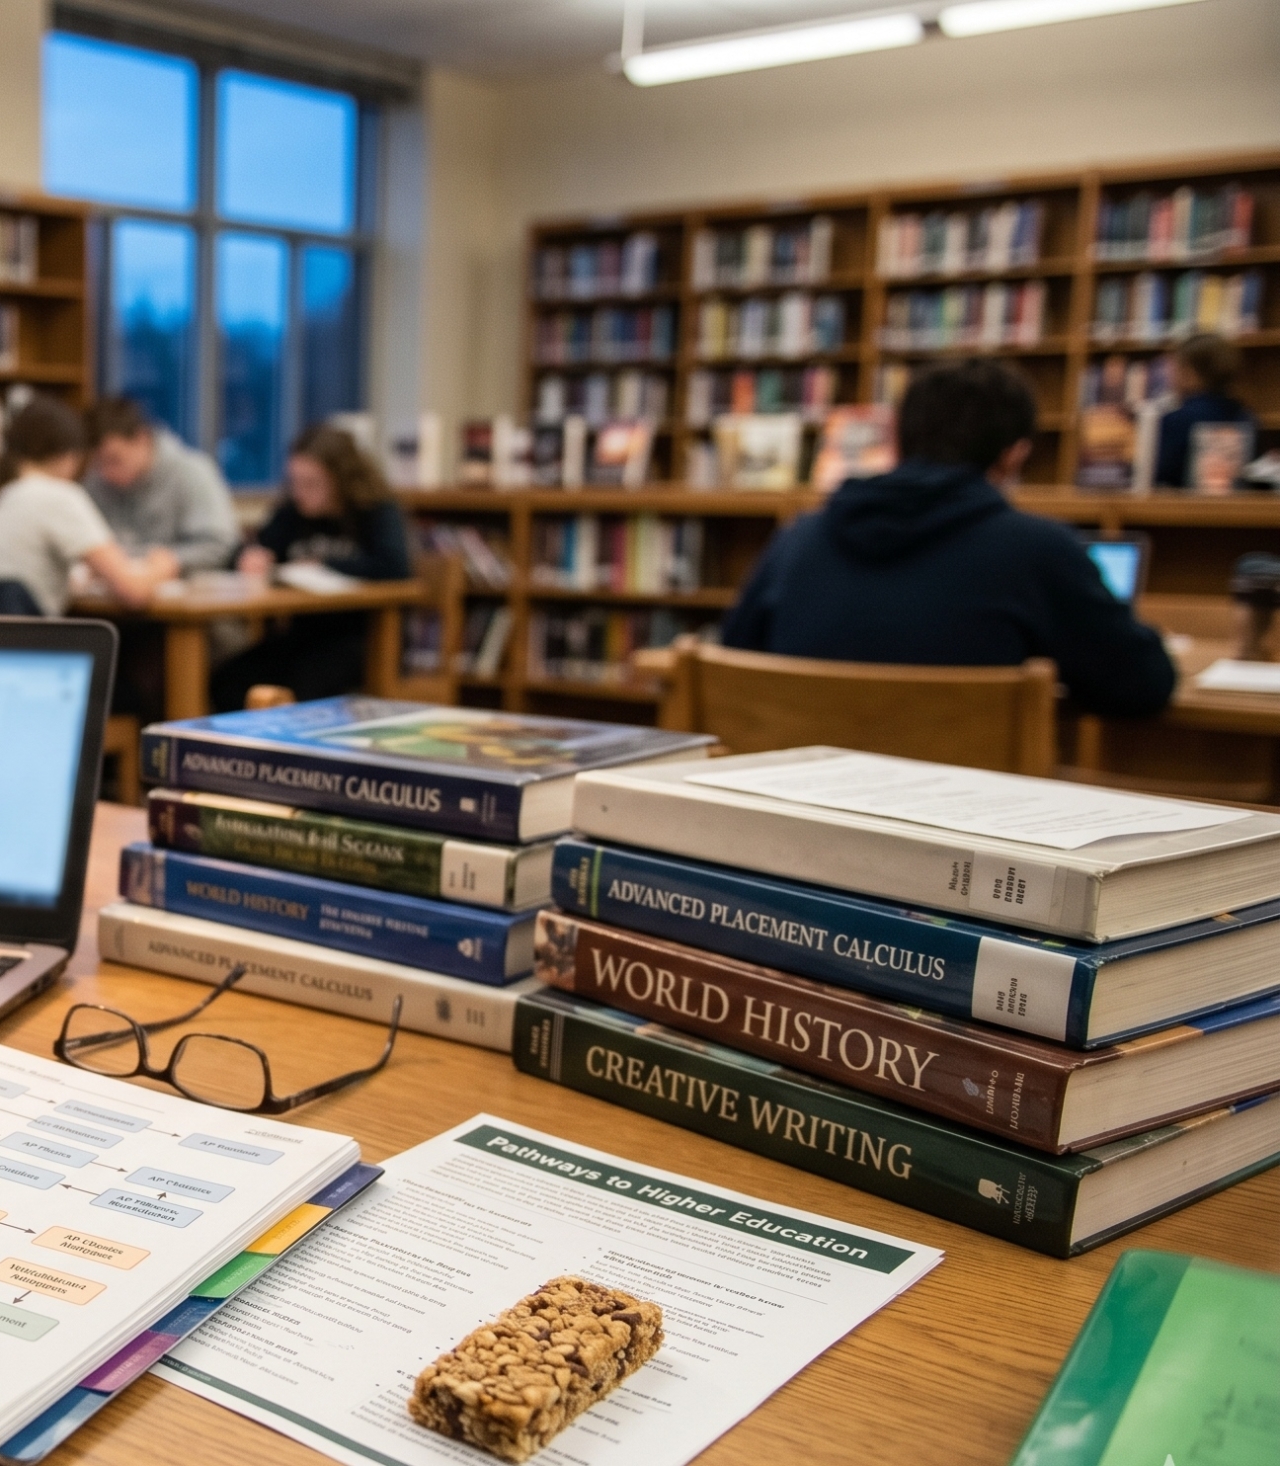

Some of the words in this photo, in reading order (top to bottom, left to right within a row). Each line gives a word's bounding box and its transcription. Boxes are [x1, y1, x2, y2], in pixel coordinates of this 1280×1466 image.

[181, 752, 257, 780] ADVANCED
[257, 763, 344, 793] PLACEMENT
[345, 776, 442, 813] CALCULUS
[186, 880, 240, 907] WORLD
[243, 892, 310, 921] HISTORY
[608, 879, 706, 921] ADVANCED
[710, 902, 828, 951] PLACEMENT
[833, 933, 946, 981] CALCULUS
[148, 940, 216, 966] ADVANCED
[218, 954, 299, 986] PLEMENT
[300, 971, 373, 1002] CALCULUS
[590, 947, 730, 1024] WORLD
[740, 994, 941, 1093] HISTORY
[585, 1045, 739, 1123] CREATIVE
[749, 1094, 913, 1180] WRITING
[486, 1135, 603, 1181] Pathways
[605, 1174, 633, 1190] to
[637, 1184, 727, 1217] Higher
[728, 1210, 870, 1260] Education
